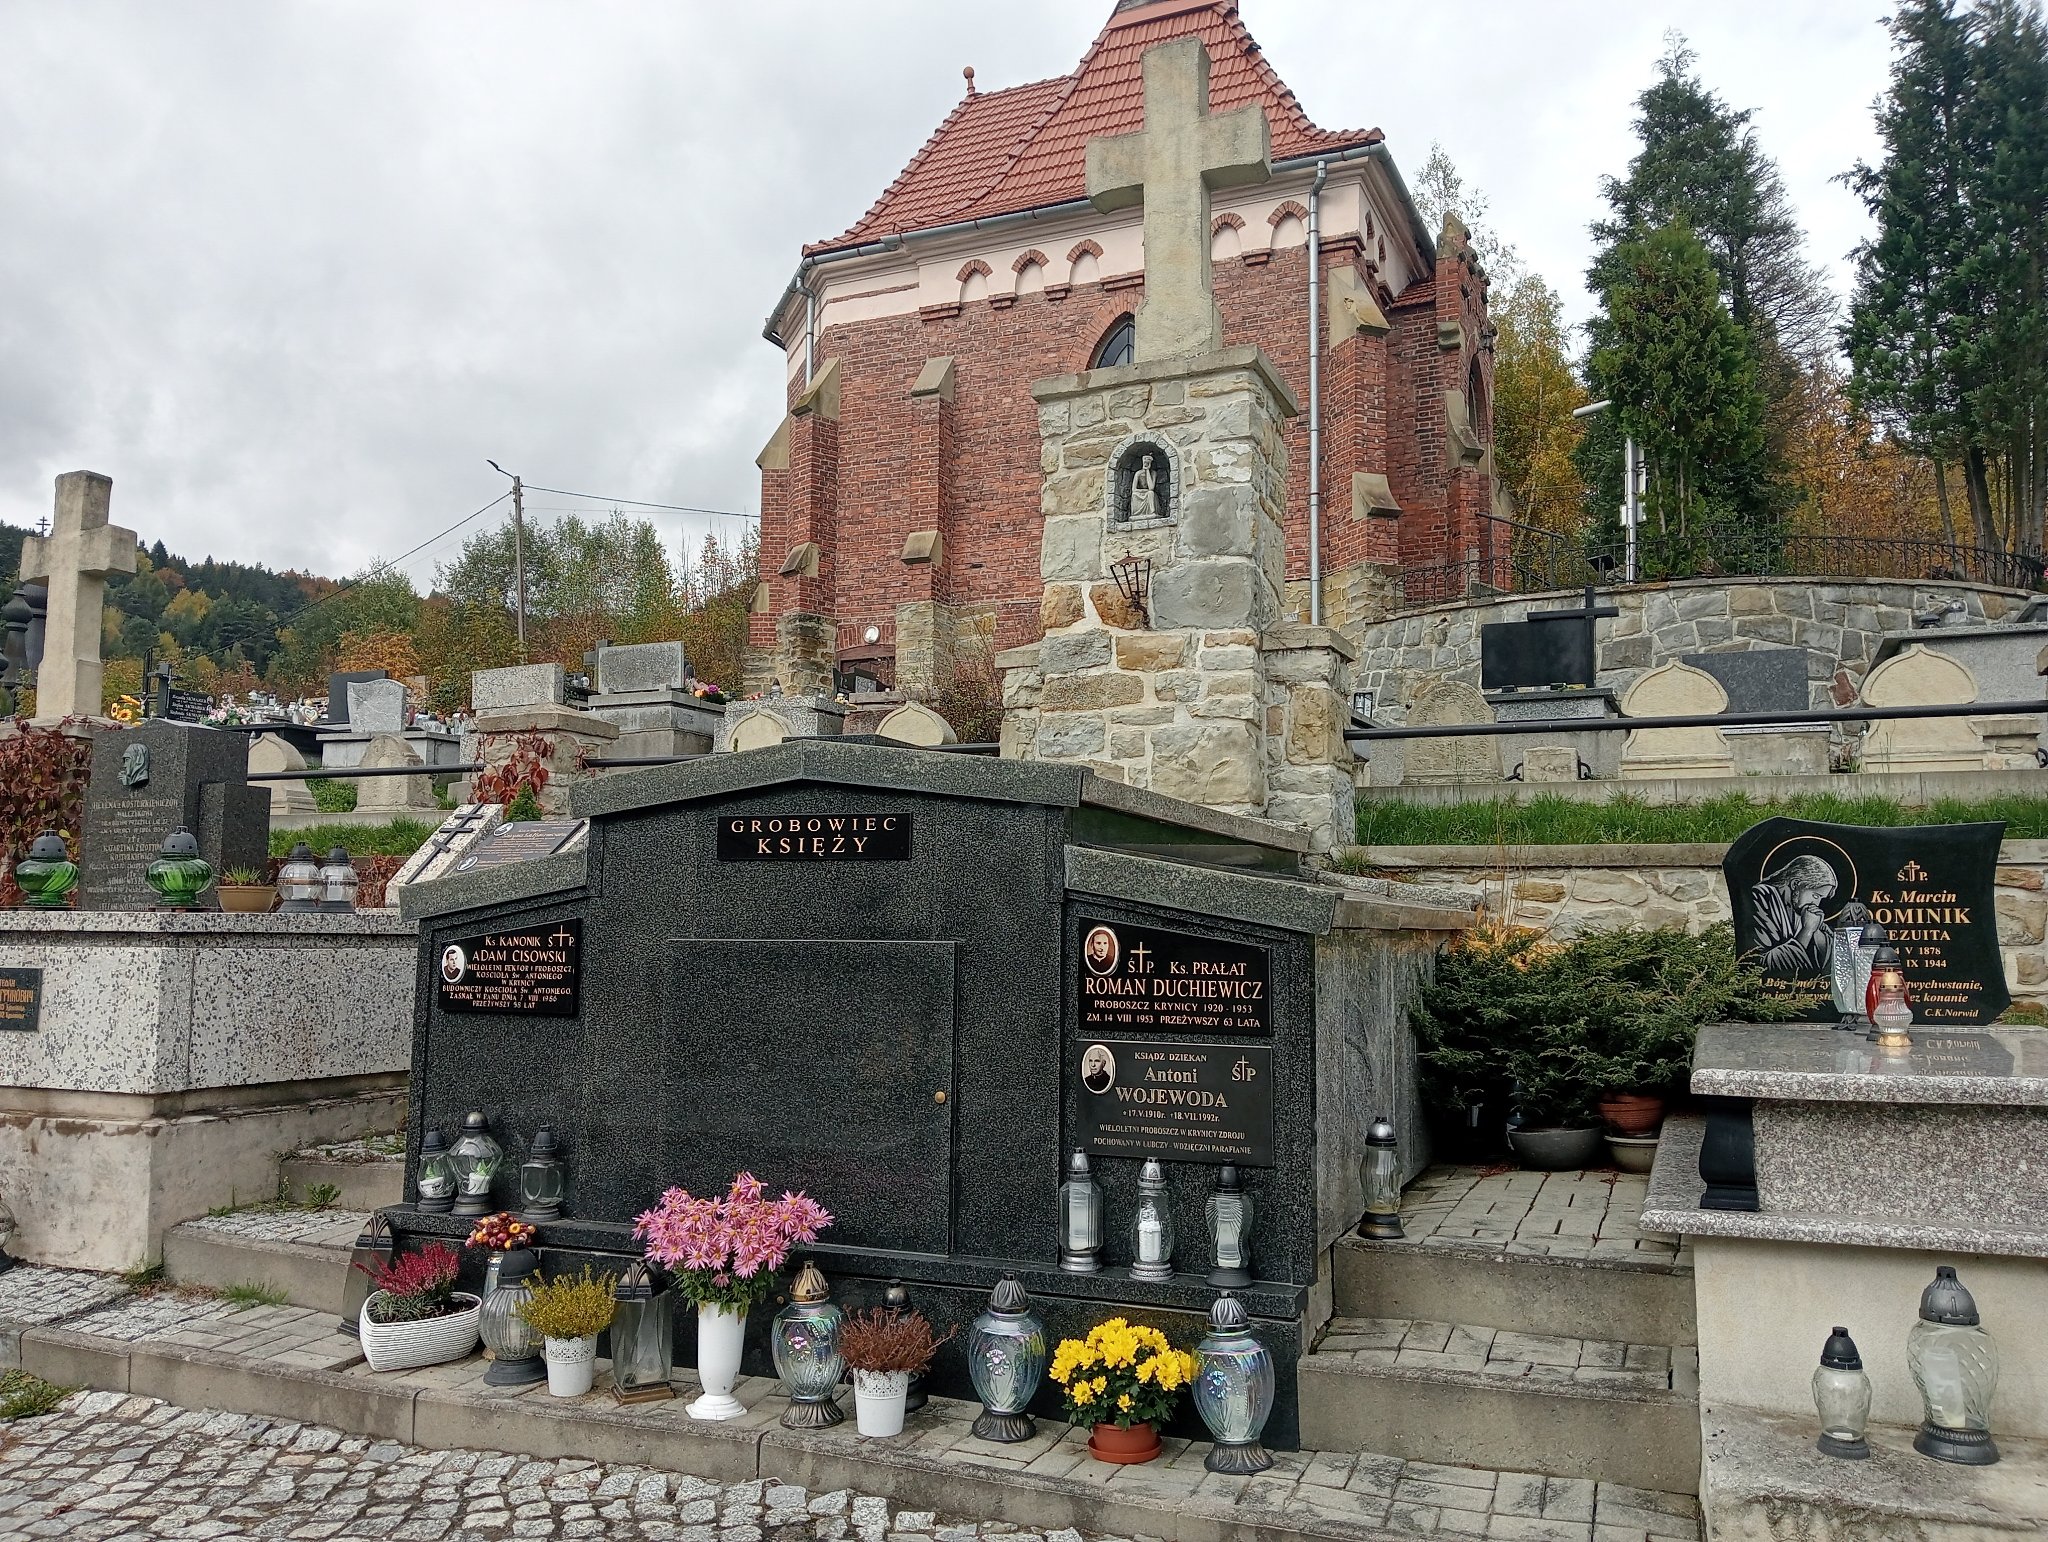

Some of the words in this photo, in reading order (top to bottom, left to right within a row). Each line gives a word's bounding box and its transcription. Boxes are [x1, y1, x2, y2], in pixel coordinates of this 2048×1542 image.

[731, 817, 897, 833] GROBOWIEC
[757, 833, 868, 857] KSIĘŻY
[1871, 890, 1894, 903] Ks.
[1900, 890, 1957, 903] Marcin
[499, 936, 541, 947] KANONIK
[1885, 929, 1951, 941] EZUITA
[472, 949, 507, 962] ADAM
[512, 950, 566, 963] CISOWSKI
[1905, 946, 1915, 955] V
[1919, 946, 1941, 955] 1878
[1170, 961, 1189, 975] Ks.
[1192, 962, 1247, 976] PRAŁAT
[1906, 959, 1919, 967] IX
[1924, 959, 1947, 968] 1944
[525, 972, 563, 980] ANTONIEGO
[1085, 977, 1146, 996] ROMAN
[1153, 978, 1263, 1000] DUCHIEWICZ
[1906, 979, 1983, 991] twychwstanie,
[1924, 993, 1969, 1003] konanie
[523, 1001, 536, 1009] LAT
[1094, 1000, 1150, 1010] PROBOSZCZ
[1154, 1002, 1198, 1011] KRYNICY
[1203, 1004, 1223, 1013] 1920
[1232, 1004, 1253, 1014] 1953
[1086, 1013, 1102, 1022] ZM.
[1104, 1013, 1114, 1022] 14
[1116, 1014, 1132, 1023] VIII
[1136, 1014, 1154, 1023] 1953
[1160, 1013, 1220, 1026] PRZEŻYWSZY
[1223, 1017, 1233, 1027] 63
[1237, 1018, 1261, 1028] LATA
[1134, 1052, 1166, 1063] KSIĄDZ
[1169, 1053, 1207, 1062] DZIEKAN
[1143, 1066, 1198, 1083] Antoni
[1115, 1086, 1229, 1108] WOJEWODA
[1099, 1124, 1140, 1134] WIELOLETNI
[1140, 1125, 1179, 1136] PROBOSZCZ
[1187, 1128, 1218, 1138] KRYNICY
[1218, 1129, 1246, 1140] ZDROJU
